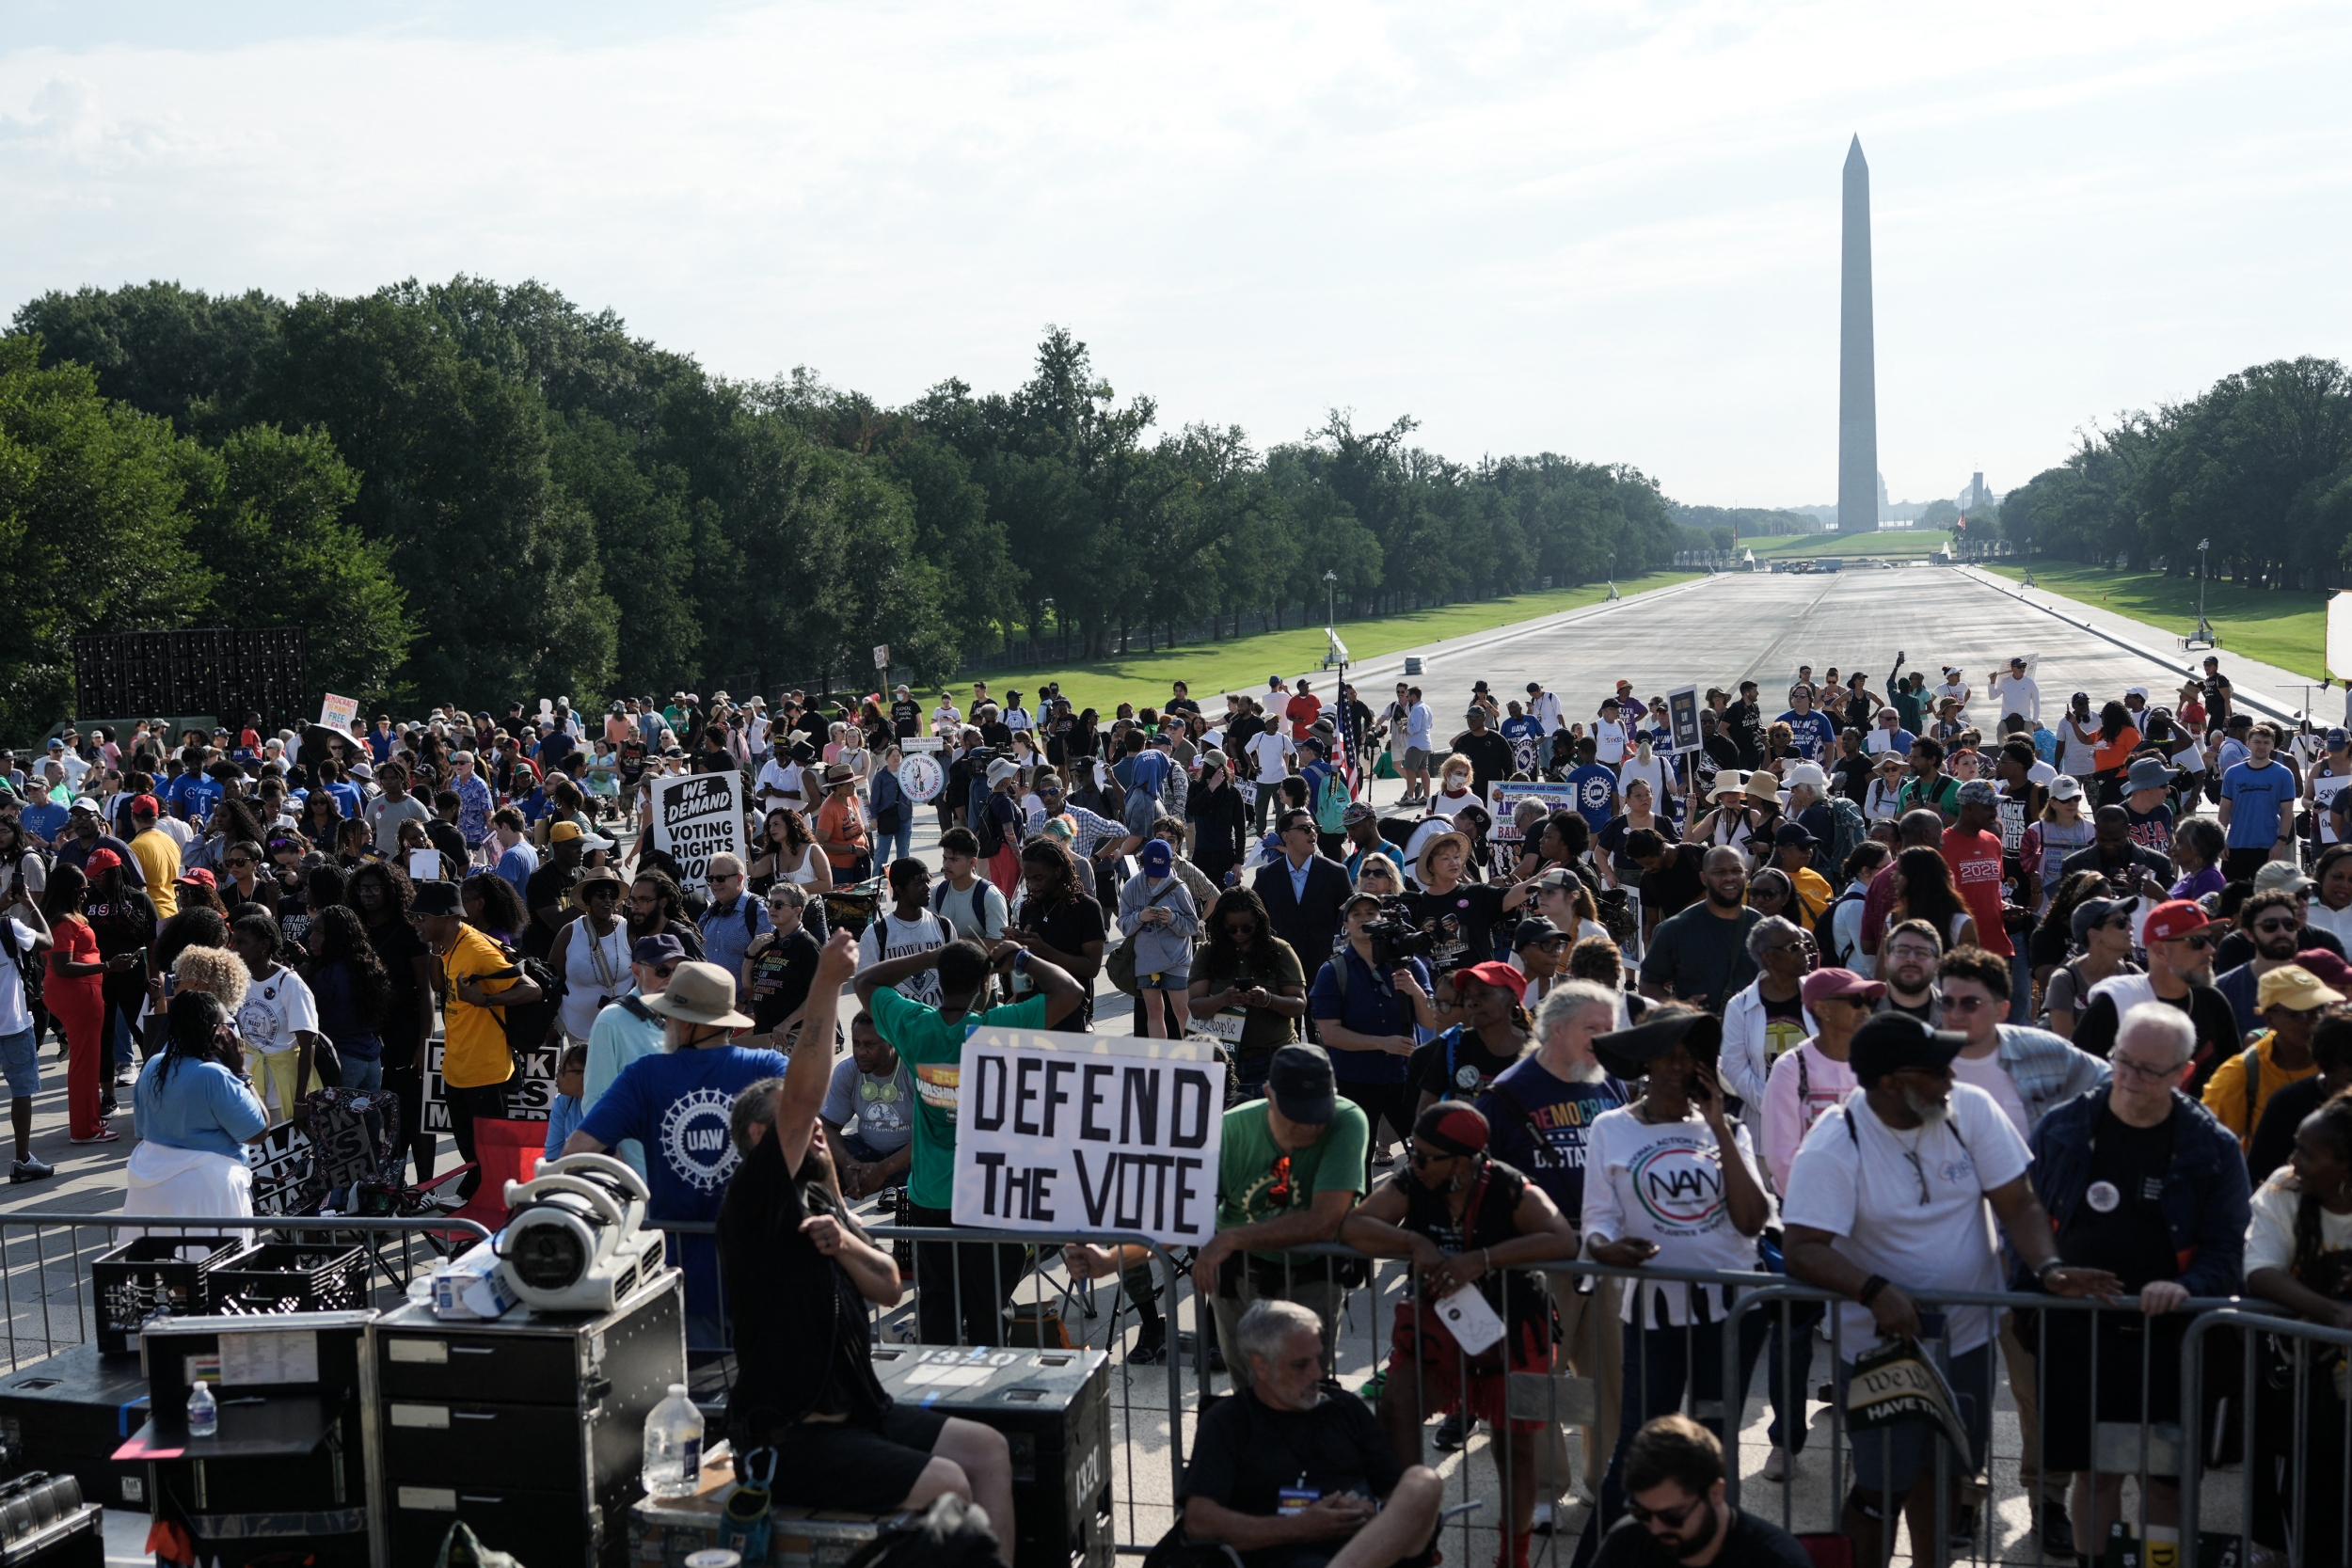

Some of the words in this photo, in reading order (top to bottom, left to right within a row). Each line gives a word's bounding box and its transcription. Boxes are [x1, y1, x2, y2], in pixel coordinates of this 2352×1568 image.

[328, 711, 345, 723] FREE
[1792, 720, 1811, 729] UAW
[1511, 724, 1527, 734] UAW
[919, 758, 933, 768] TURN
[682, 779, 707, 800] WE
[903, 783, 918, 798] FIGHT
[1590, 788, 1603, 798] UAW
[668, 792, 730, 822] DEMAND
[668, 820, 732, 842] VOTING
[672, 837, 734, 860] RIGHTS
[677, 858, 711, 881] NO
[1961, 863, 2000, 879] 2026
[283, 914, 295, 924] YOU
[903, 988, 943, 1006] ISON
[974, 1055, 1212, 1149] DEFEND
[1529, 1098, 1620, 1129] DEMOCR
[687, 1129, 724, 1151] UAW
[976, 1151, 1057, 1223] THE
[1073, 1148, 1202, 1234] VOTE
[1648, 1168, 1721, 1200] NAN
[916, 1347, 1018, 1367] 1320
[1867, 1396, 1917, 1420] HAVE
[1075, 1444, 1101, 1509] 1320
